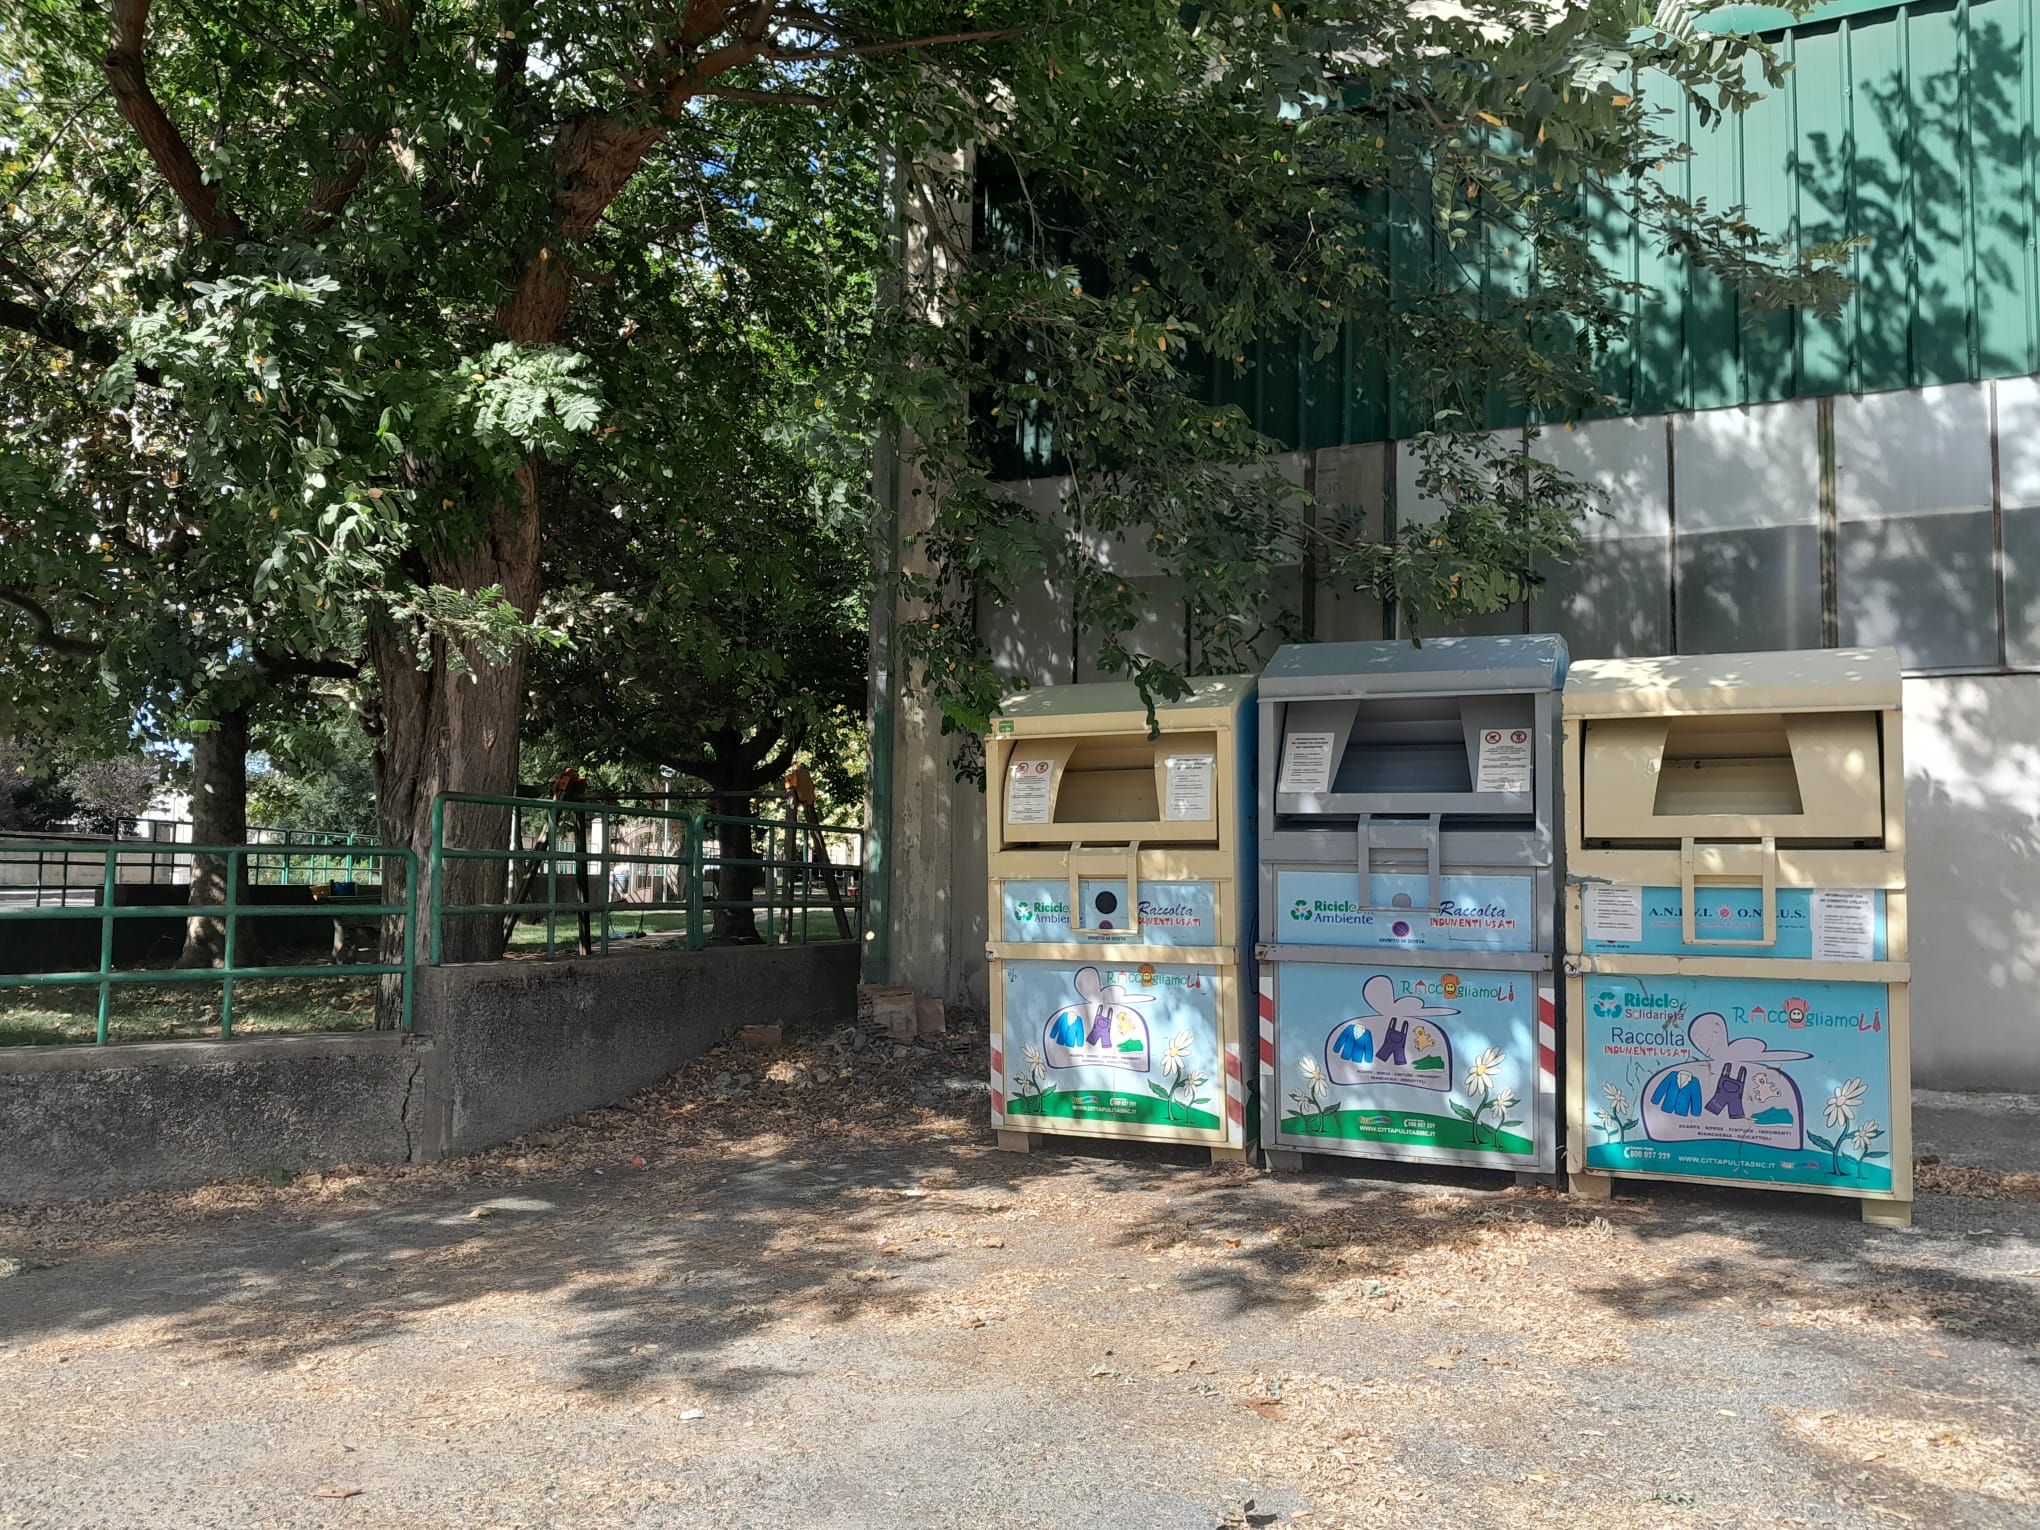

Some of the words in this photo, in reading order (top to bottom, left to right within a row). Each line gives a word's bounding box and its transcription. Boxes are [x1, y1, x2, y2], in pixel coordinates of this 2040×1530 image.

[1138, 901, 1193, 916] Raccolta
[1314, 900, 1357, 912] Riciclo
[1440, 900, 1506, 917] Raccolta
[1034, 913, 1084, 924] Ambiene
[1314, 913, 1374, 925] Ambiente
[1737, 908, 1806, 918] O.N.U.S.
[1176, 917, 1201, 927] USATI
[1430, 917, 1482, 928] INDUMENTI
[1485, 918, 1516, 929] USATI
[1624, 992, 1679, 1008] Riciclo
[1611, 1026, 1685, 1047] Raccolta
[1604, 1045, 1657, 1056] INDUMENTI
[1660, 1047, 1691, 1058] USATI
[1678, 1155, 1776, 1169] WWW.CITTAPULITASNC.IT
